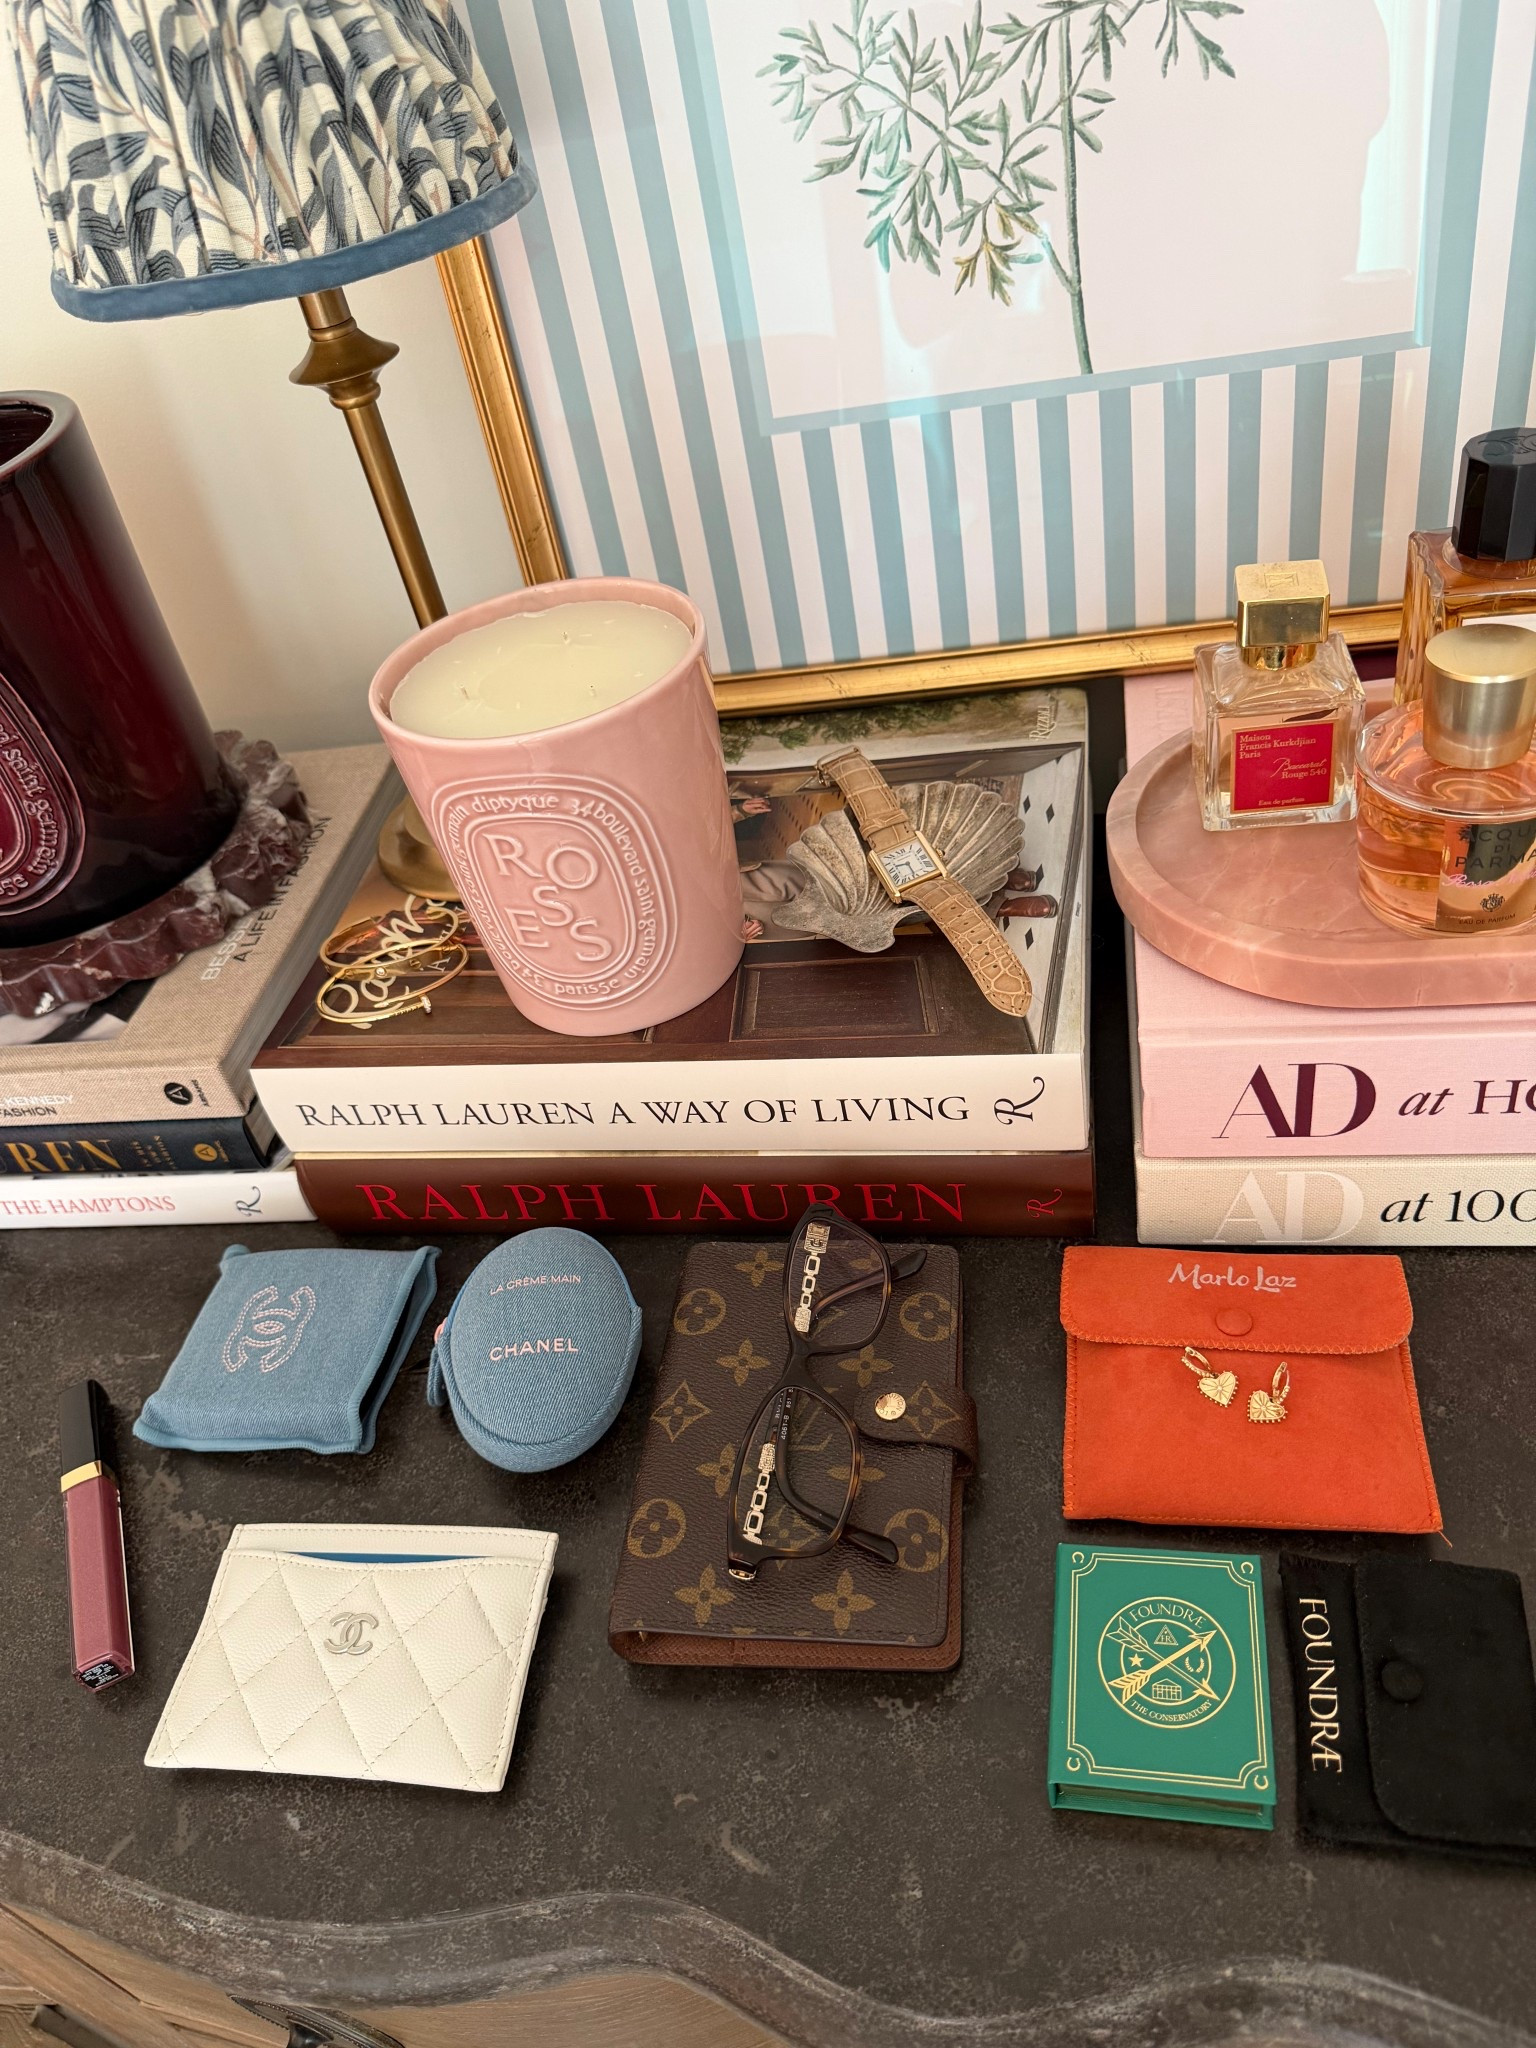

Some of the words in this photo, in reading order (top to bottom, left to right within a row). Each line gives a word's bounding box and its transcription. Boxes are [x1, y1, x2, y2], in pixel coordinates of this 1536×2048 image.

[1240, 734, 1271, 743] Maison
[1240, 742, 1271, 751] Francis
[1273, 738, 1316, 748] Kurkdjian
[1240, 751, 1261, 759] Paris
[1270, 757, 1327, 778] Baccarat
[1281, 769, 1308, 779] Rouge
[1309, 768, 1327, 776] 540
[472, 793, 560, 814] diptyque
[241, 909, 277, 952] LIFE
[4, 1094, 73, 1107] KENNEDY
[296, 1104, 426, 1127] RALPH
[432, 1102, 596, 1126] LAUREN
[609, 1102, 636, 1124] A
[641, 1100, 730, 1124] WAY
[743, 1099, 797, 1124] OF
[810, 1096, 970, 1123] LIVING
[1211, 1062, 1376, 1139] AD
[1399, 1088, 1454, 1116] at
[0, 1106, 58, 1118] ASHION
[0, 1139, 122, 1174] REN
[1, 1200, 47, 1215] THE
[48, 1196, 177, 1214] HAMPTONS
[355, 1183, 616, 1221] RALPH
[636, 1182, 967, 1222] LAUREN
[1201, 1170, 1364, 1243] AD
[1380, 1193, 1433, 1223] at
[490, 1284, 504, 1296] LA
[551, 1274, 581, 1284] MAIN
[1168, 1262, 1249, 1289] Marlo
[1253, 1265, 1297, 1292] Laz
[489, 1337, 579, 1361] CHANEL
[1131, 1699, 1149, 1715] THE
[1148, 1699, 1213, 1722] CONSERVATORY
